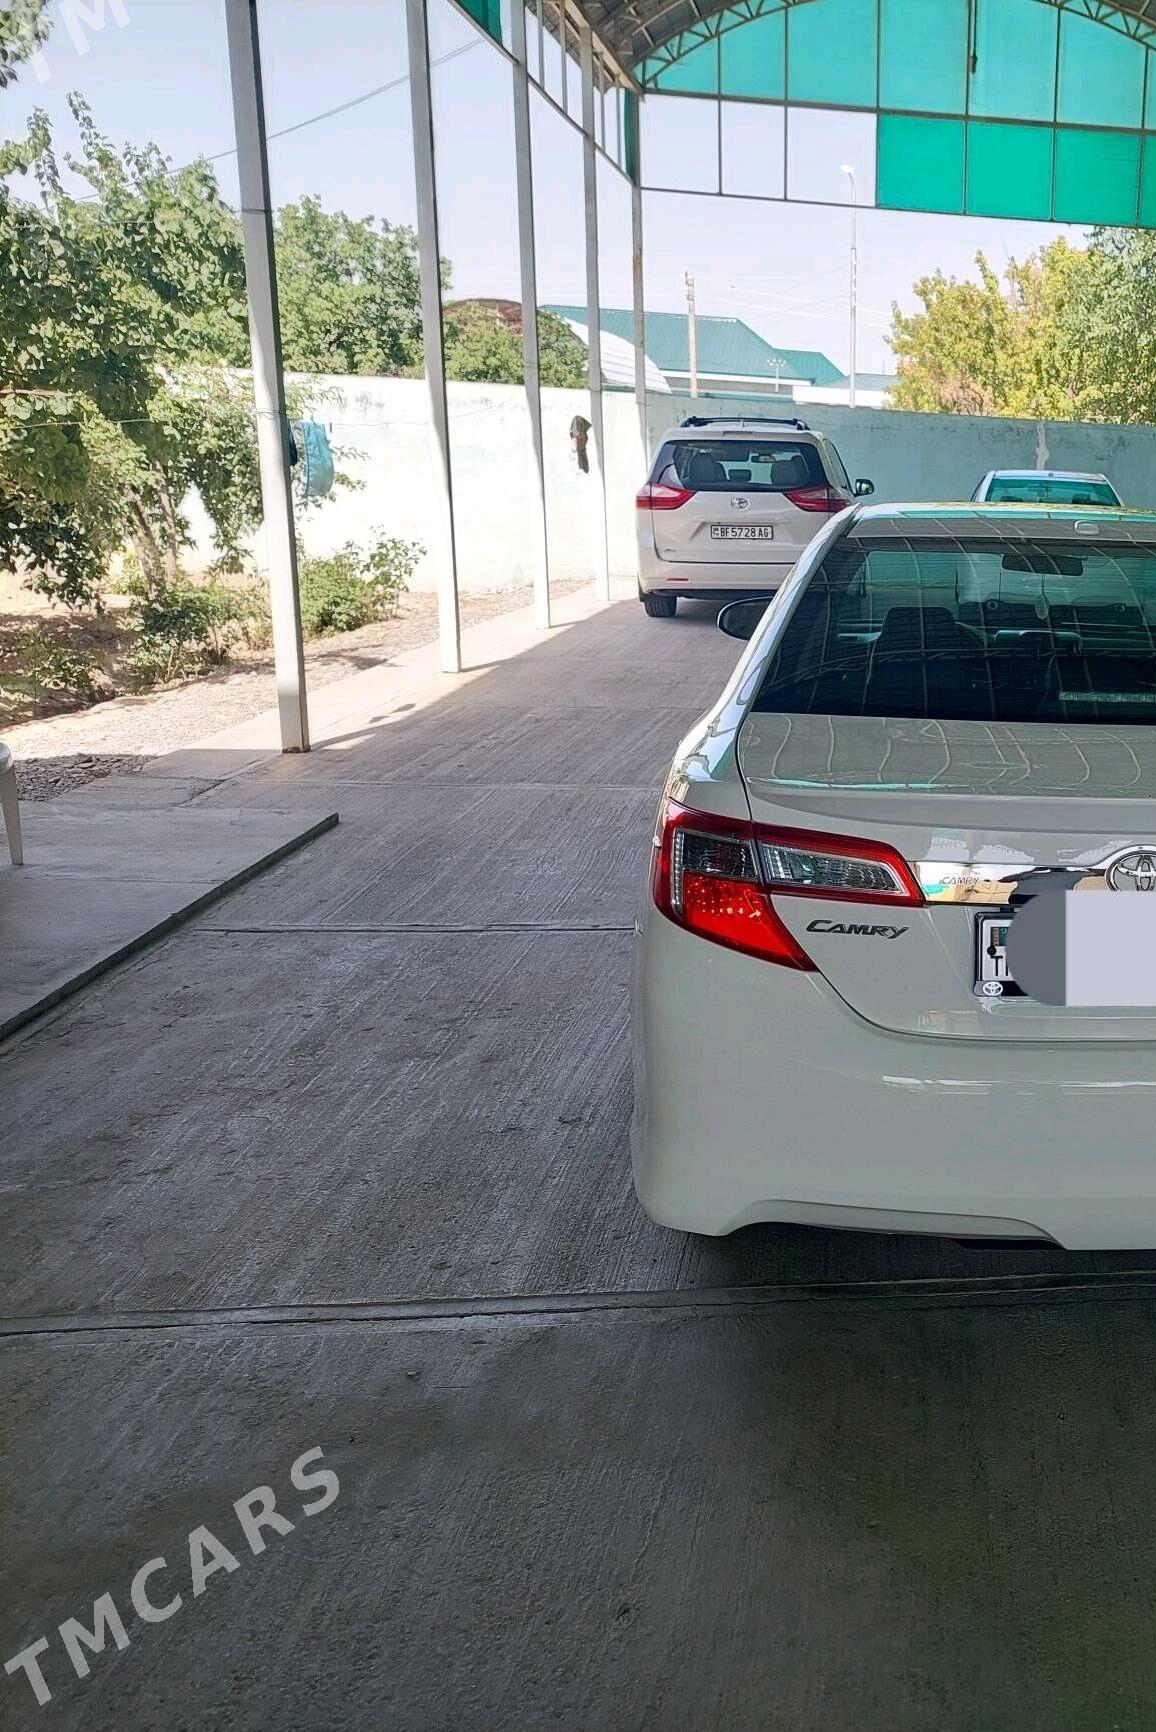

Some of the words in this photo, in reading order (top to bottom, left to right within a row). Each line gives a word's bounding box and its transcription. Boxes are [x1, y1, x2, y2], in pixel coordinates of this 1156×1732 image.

[731, 527, 756, 538] 5728
[758, 527, 769, 538] AG
[941, 876, 980, 885] CAMRY
[806, 919, 910, 939] CAMRY
